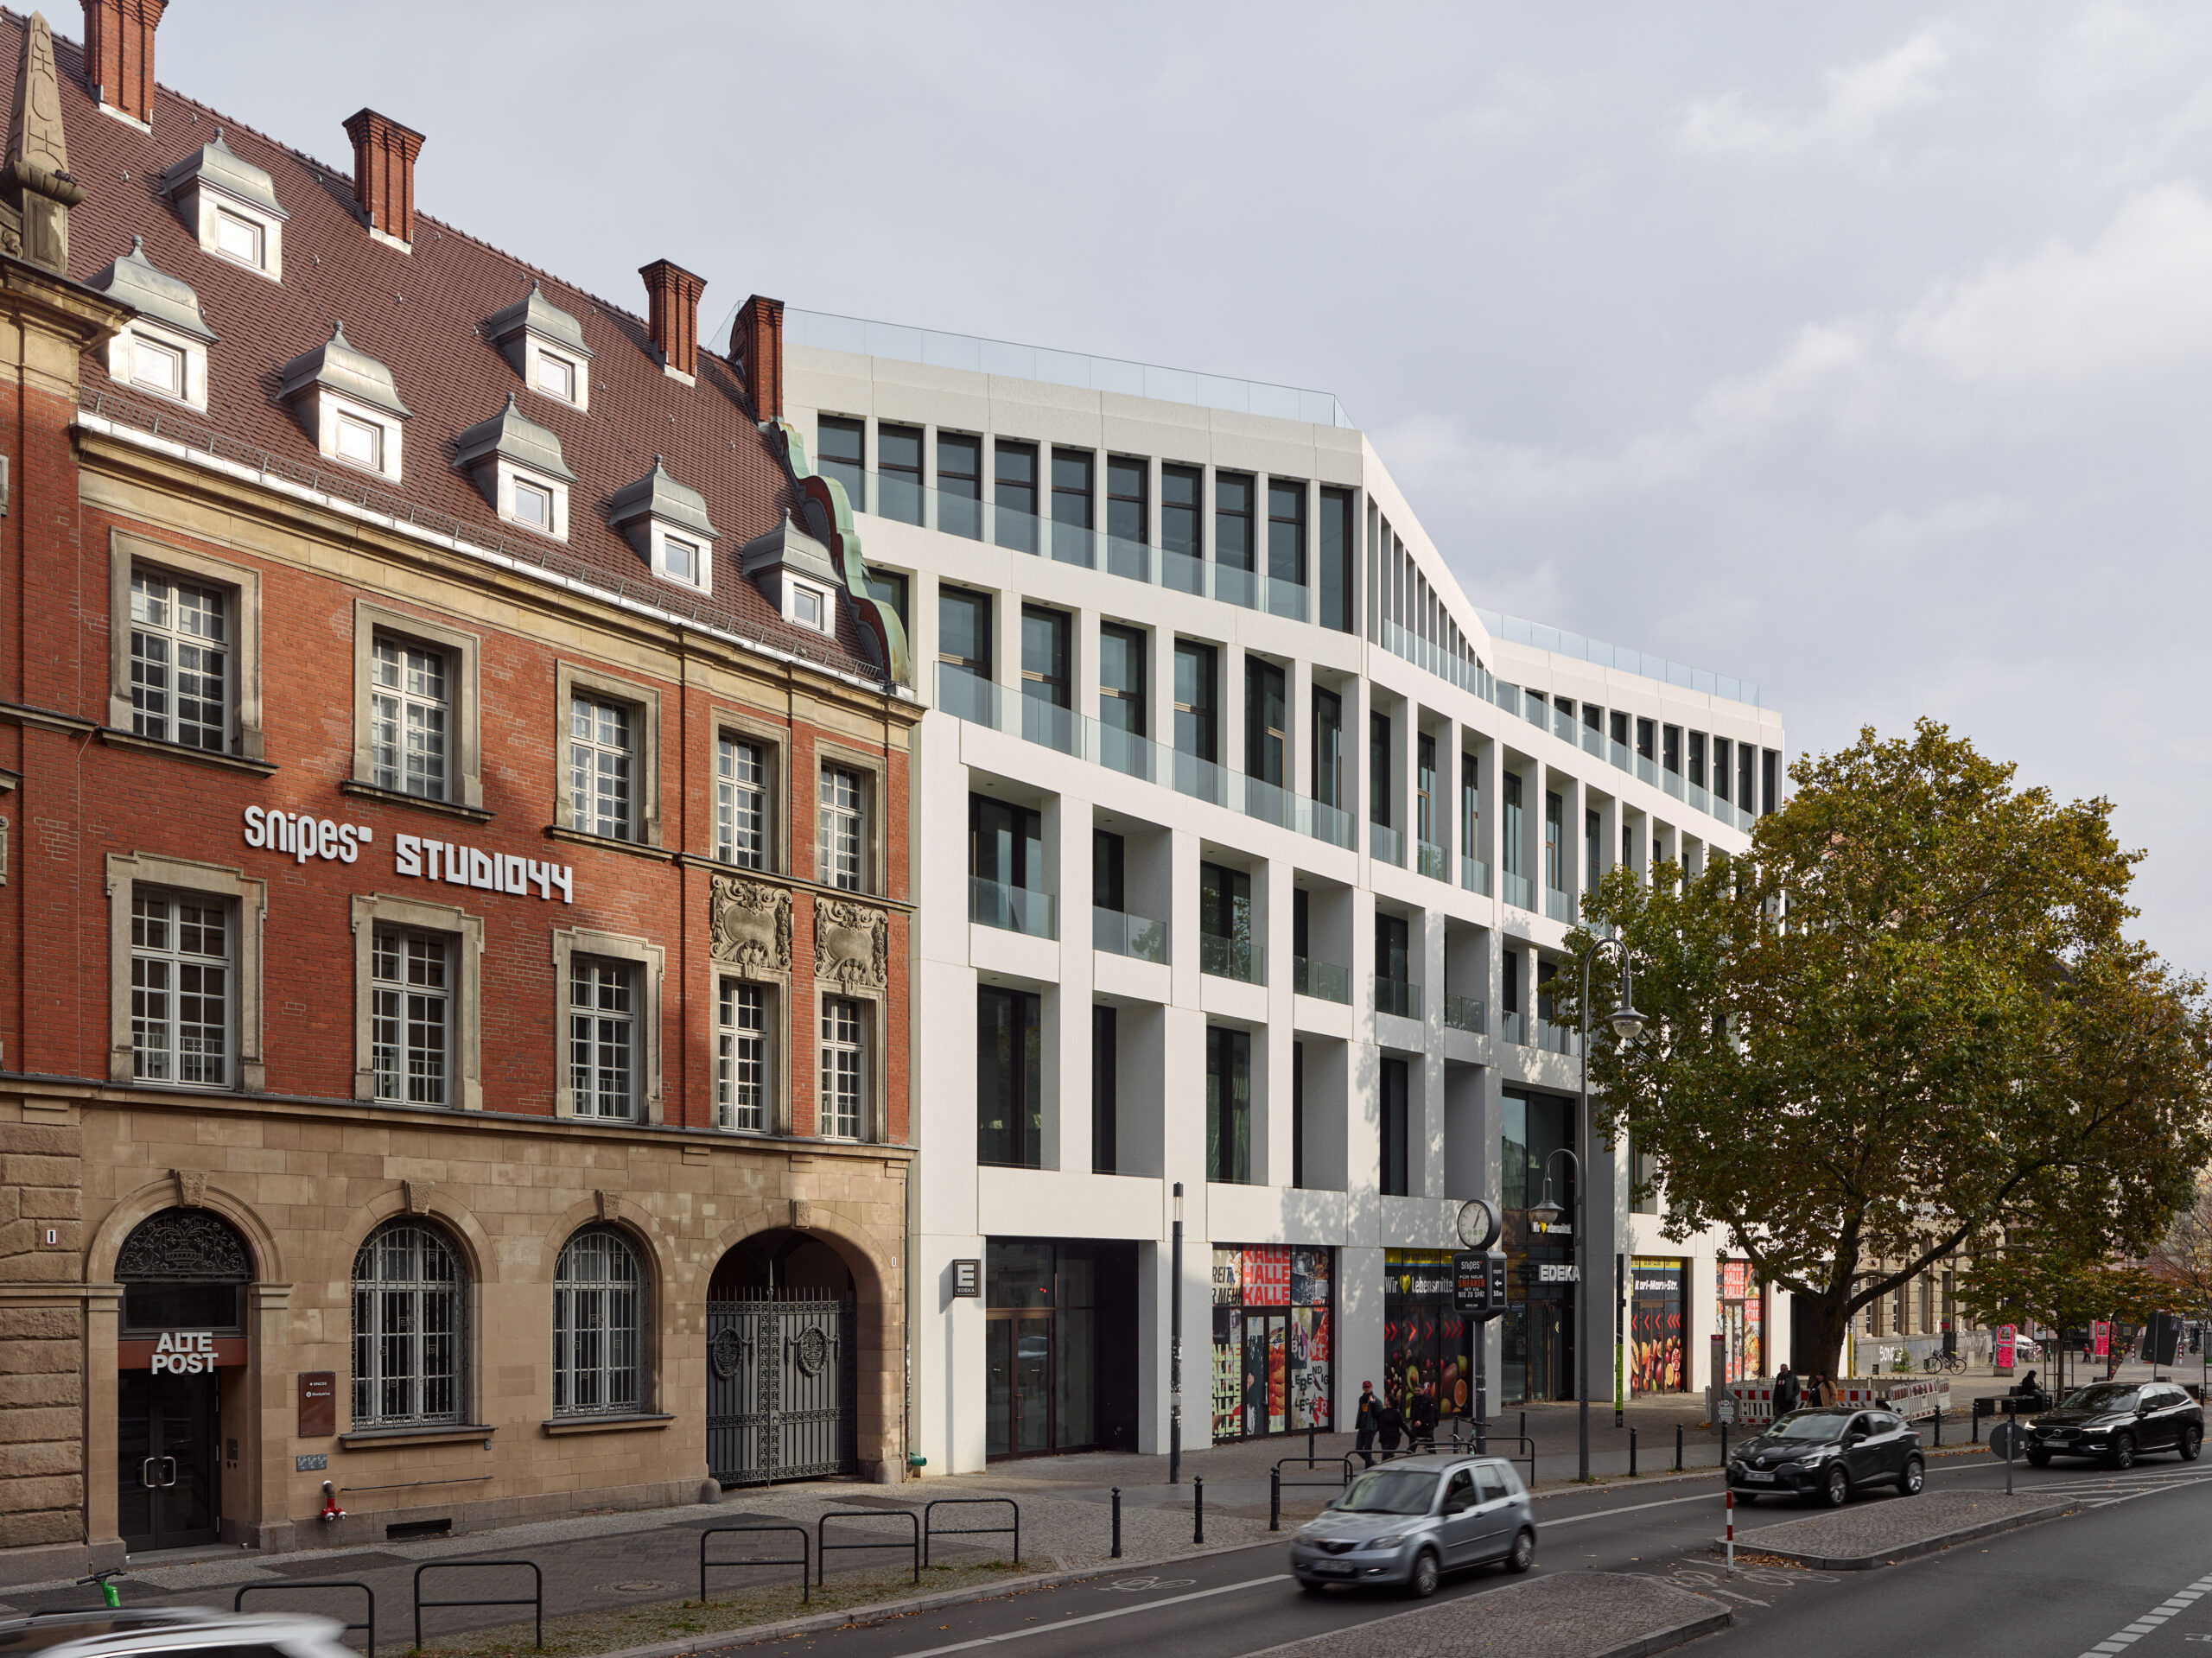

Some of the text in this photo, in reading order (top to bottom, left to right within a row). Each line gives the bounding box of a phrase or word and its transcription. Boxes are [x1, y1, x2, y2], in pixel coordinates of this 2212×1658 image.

[244, 805, 359, 863] snipes
[1243, 1265, 1290, 1285] HALLE
[1460, 1261, 1480, 1271] snipes
[1539, 1264, 1581, 1281] EDEKA
[1385, 1276, 1398, 1293] Wir
[1458, 1279, 1485, 1287] SNEAKER
[1243, 1286, 1290, 1305] KALLE
[156, 1331, 213, 1353] ALTE
[150, 1352, 219, 1375] POST
